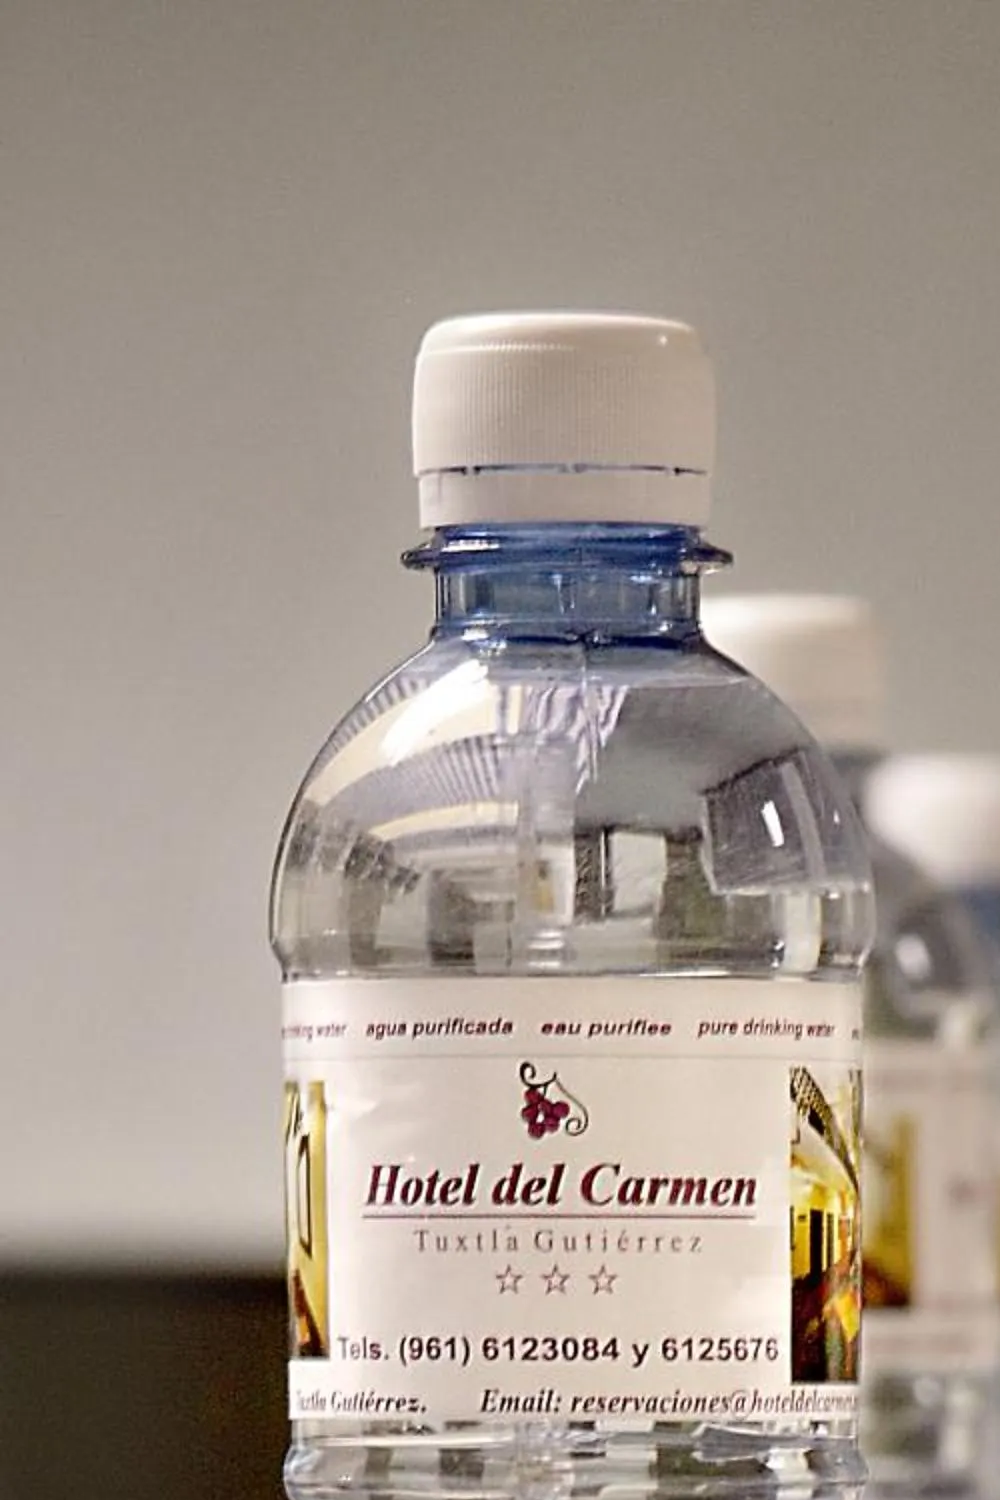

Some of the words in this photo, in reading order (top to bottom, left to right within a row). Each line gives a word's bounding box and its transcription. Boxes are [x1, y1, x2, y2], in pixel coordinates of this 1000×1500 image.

[366, 1020, 407, 1040] agua
[412, 1016, 513, 1040] purificada
[541, 1020, 581, 1037] eau
[587, 1018, 672, 1038] purifiee
[698, 1019, 738, 1038] pure
[743, 1017, 803, 1041] drinking
[365, 1162, 481, 1207] Hotel
[491, 1162, 566, 1207] del
[580, 1160, 758, 1207] Carmen
[533, 1228, 703, 1254] Gutiérrez
[337, 1337, 390, 1361] Tels.
[399, 1336, 471, 1367] (961)
[481, 1336, 620, 1361] 6123084
[631, 1342, 650, 1368] y
[661, 1337, 779, 1361] 6125676
[330, 1389, 427, 1413] Gutiérrez.
[480, 1389, 562, 1413] Email:
